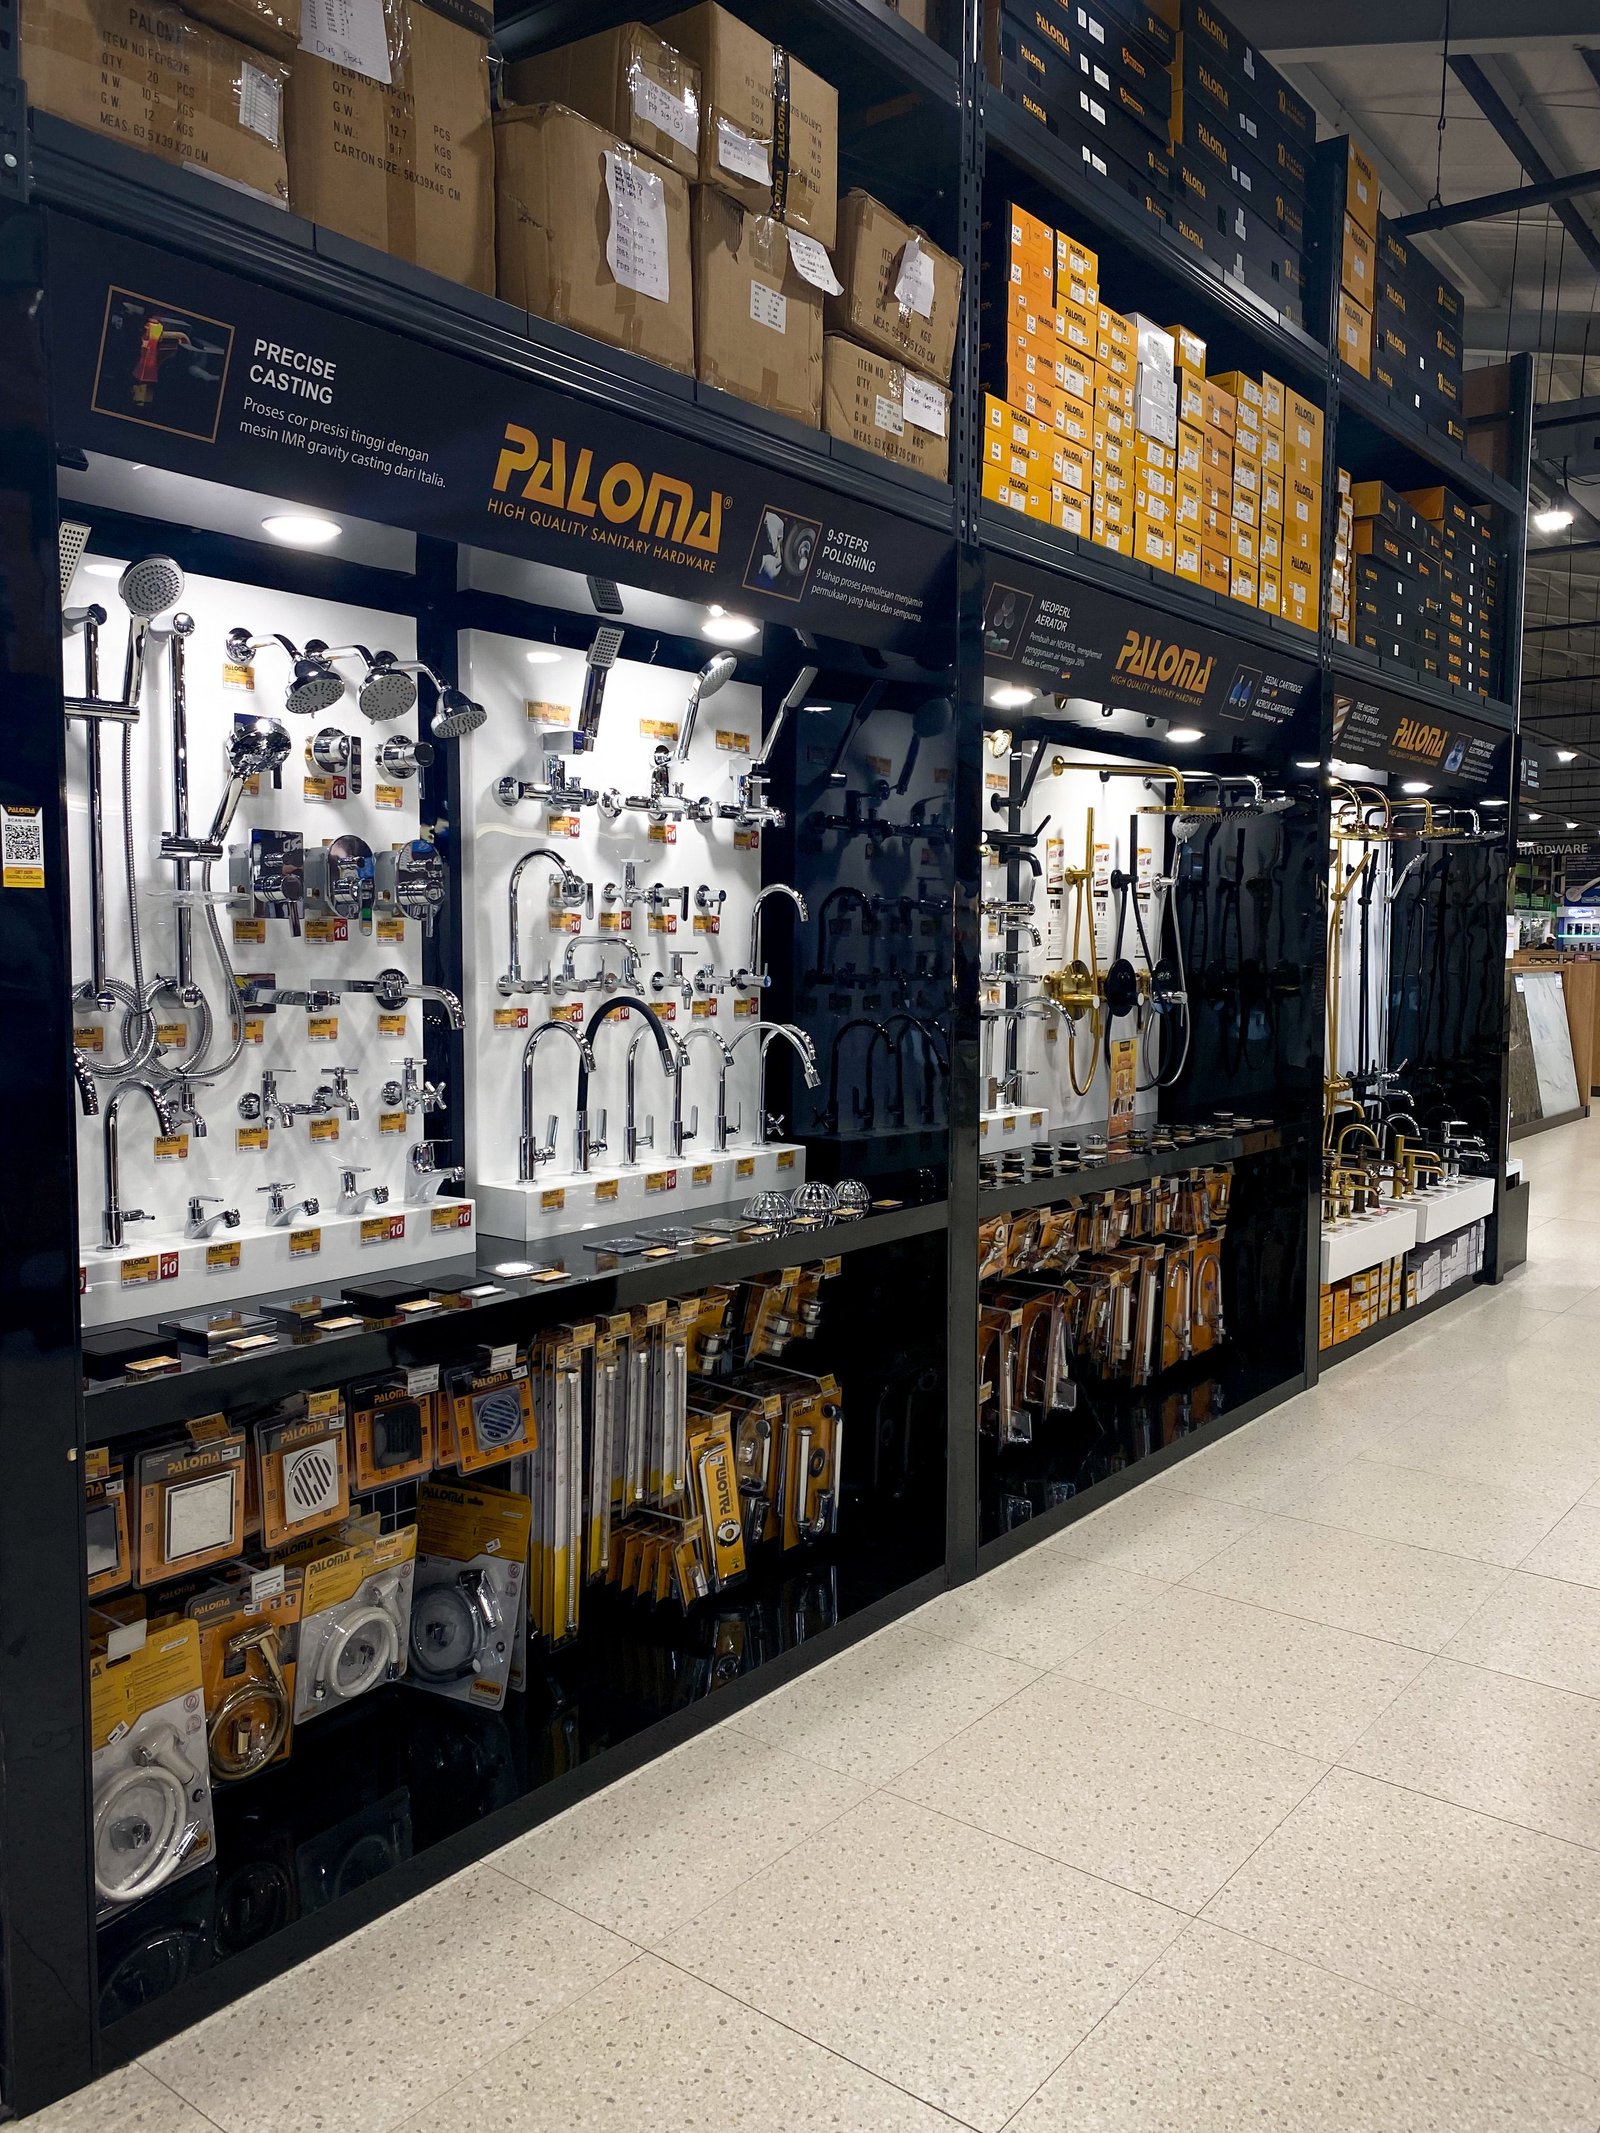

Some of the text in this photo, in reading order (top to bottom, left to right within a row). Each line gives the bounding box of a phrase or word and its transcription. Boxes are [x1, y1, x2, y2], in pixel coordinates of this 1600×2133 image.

[1036, 11, 1070, 53] PALOMA
[1197, 6, 1228, 49] PALOMA
[103, 31, 128, 50] ITEM
[1020, 45, 1046, 74] PALOMA
[147, 70, 195, 99] 20 PCS
[1199, 65, 1229, 108] PALOMA
[177, 101, 195, 118] KGS
[332, 81, 451, 142] QTY: PCS
[1022, 94, 1047, 123] PALOMA
[144, 108, 194, 138] 12 KGS
[434, 144, 452, 161] KGS
[1198, 123, 1228, 164] PALOMA
[194, 147, 209, 164] CM
[334, 141, 375, 166] CARTON
[448, 188, 461, 202] CM
[434, 162, 452, 179] KGS
[1182, 167, 1206, 198] PALOMA
[1178, 220, 1204, 250] PALOMA
[1387, 234, 1407, 265] PALOMA
[1386, 283, 1406, 314] PALOMA
[1064, 306, 1087, 326] PALOMA
[1386, 330, 1407, 357] PALOMA
[254, 338, 337, 381] PRECISE
[857, 358, 873, 374] ITEM
[1065, 354, 1085, 373] PALOMA
[250, 364, 334, 405] CASTING
[1064, 402, 1084, 419] PALOMA
[1295, 403, 1316, 426] PALOMA
[244, 396, 430, 463] Proses cor presisi tinggi dengan
[240, 421, 446, 488] mesin IMR gravity casting dari Italia.
[1010, 443, 1030, 459] PALOMA
[1063, 447, 1083, 464] PALOMA
[492, 422, 722, 554] PALOMA
[1009, 477, 1029, 493] PALOMA
[487, 498, 717, 574] HIGH QUALITY SANITARY HARDWARE
[827, 529, 869, 553] 9-STEPS
[822, 546, 877, 573] POLISHING
[1291, 556, 1312, 575] PALOMA
[816, 568, 821, 578] 9
[822, 571, 840, 584] tahap
[840, 578, 861, 590] proses
[861, 583, 894, 600] pemolesan
[811, 585, 848, 602] permukaan
[847, 595, 864, 608] yang
[864, 598, 881, 611] halus
[880, 604, 893, 614] dan
[1040, 600, 1071, 619] NEOPERL
[1035, 614, 1068, 632] AERATOR
[1021, 656, 1034, 667] Made
[1040, 660, 1061, 674] Germany
[1115, 630, 1214, 694] PALOMA
[1110, 674, 1203, 705] HIGH QUALITY SANITARY HARDWARE
[1264, 675, 1304, 695] SEDAL CARTRIDGE
[1255, 698, 1296, 717] KEROX CARTRIDGE
[1351, 711, 1367, 723] QUALITY
[1356, 702, 1365, 711] THE
[1392, 717, 1449, 758] PALOMA
[8, 806, 36, 814] PALOMA
[1520, 844, 1589, 856] HARDWARE
[208, 1243, 233, 1253] PALOMA
[123, 1257, 150, 1267] PALOMA
[472, 1372, 509, 1389] PALOMA
[310, 1392, 332, 1402] PALOMA
[374, 1390, 408, 1404] PALOM
[191, 1418, 217, 1428] PALOMA
[281, 1420, 325, 1444] PALOMA
[167, 1451, 221, 1475] PALOMA
[422, 1487, 465, 1505] PALOMA
[273, 1538, 314, 1562] PALOMA
[309, 1553, 351, 1573] PALOMA
[159, 1583, 196, 1602] PALOMA
[194, 1597, 231, 1616] PALOMA
